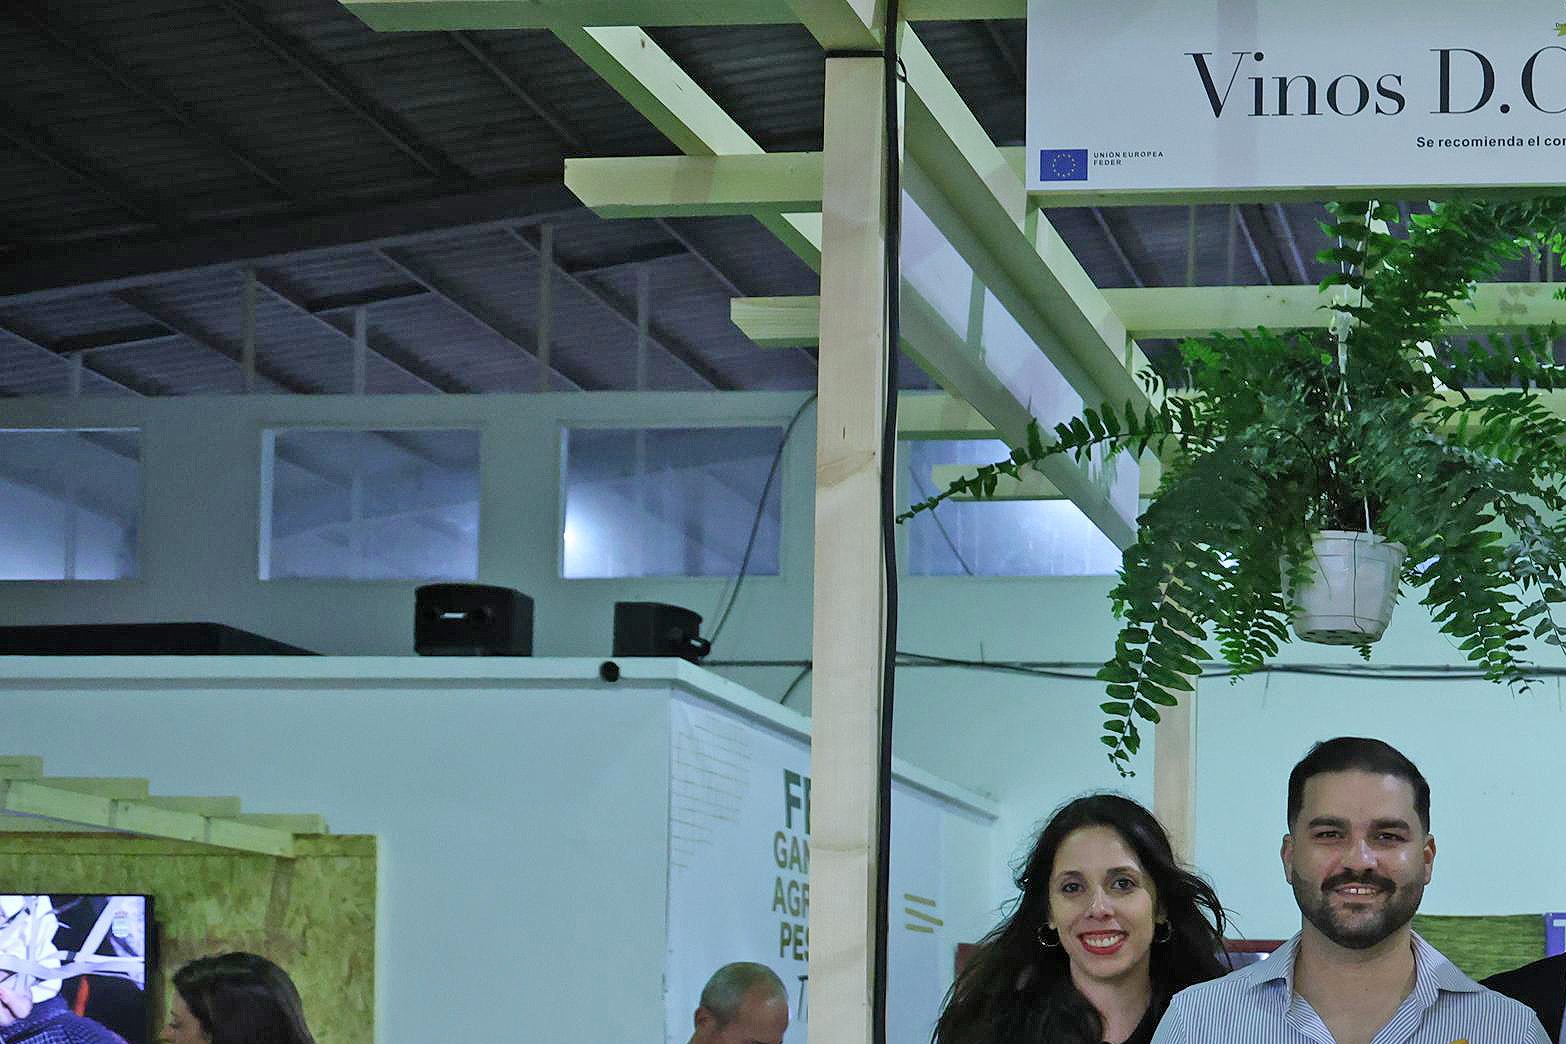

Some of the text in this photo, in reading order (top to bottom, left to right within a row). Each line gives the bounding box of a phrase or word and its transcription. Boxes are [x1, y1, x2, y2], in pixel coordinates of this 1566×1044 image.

[1184, 52, 1406, 118] Vinos
[1416, 136, 1434, 147] Se
[1438, 135, 1523, 147] recomienda
[1527, 135, 1540, 146] el
